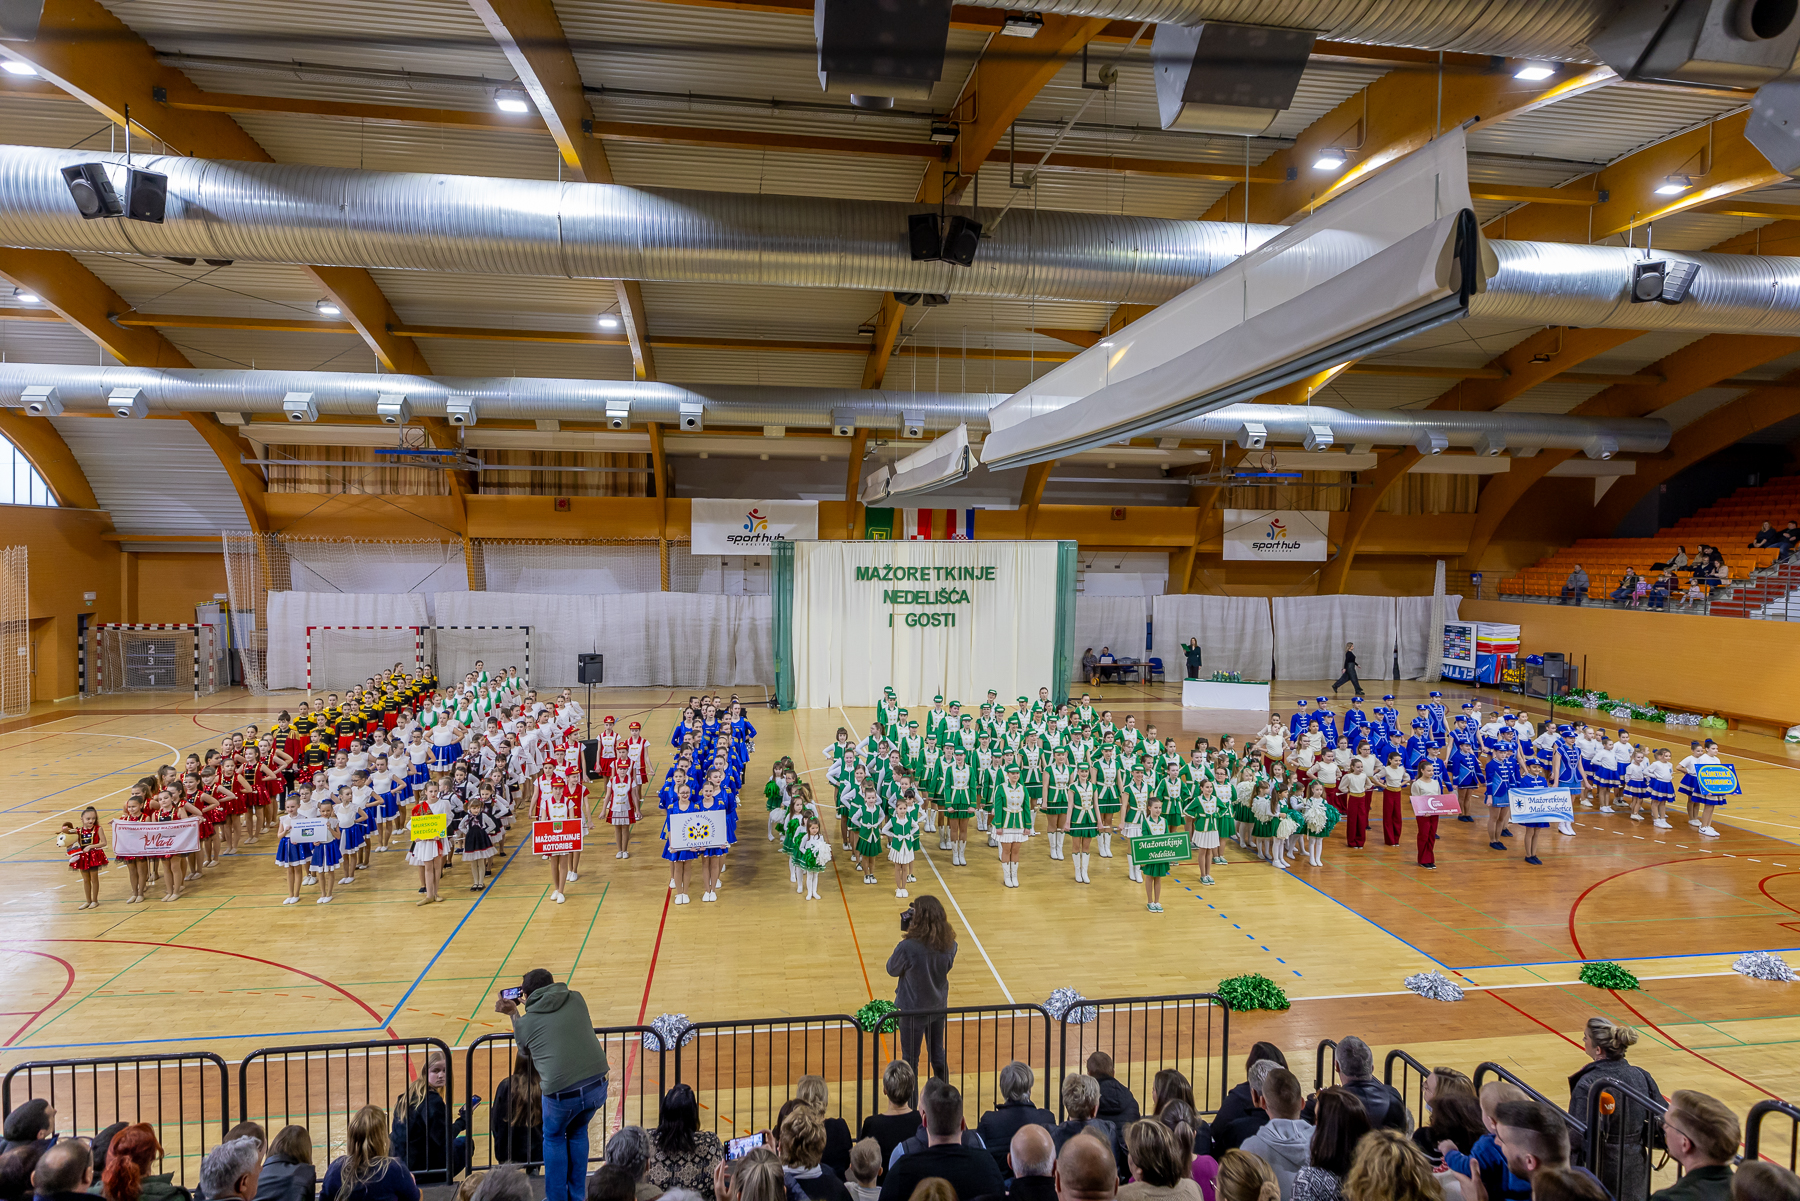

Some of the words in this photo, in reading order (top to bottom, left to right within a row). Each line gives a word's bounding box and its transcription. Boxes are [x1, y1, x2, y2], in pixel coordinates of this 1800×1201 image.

[727, 533, 761, 544] sport
[1252, 541, 1281, 551] sport
[1281, 541, 1301, 549] hub
[856, 564, 996, 582] MAŽORETKINJE
[883, 587, 971, 605] NEDELIŠĆA
[888, 613, 893, 628] I
[905, 612, 956, 628] GOSTI
[148, 645, 155, 654] 2
[148, 657, 154, 665] 3
[148, 674, 155, 685] 1
[535, 833, 580, 843] MAŽORETKINJE
[1138, 838, 1183, 849] Mažoretkinje
[542, 842, 573, 851] KOTORIBE
